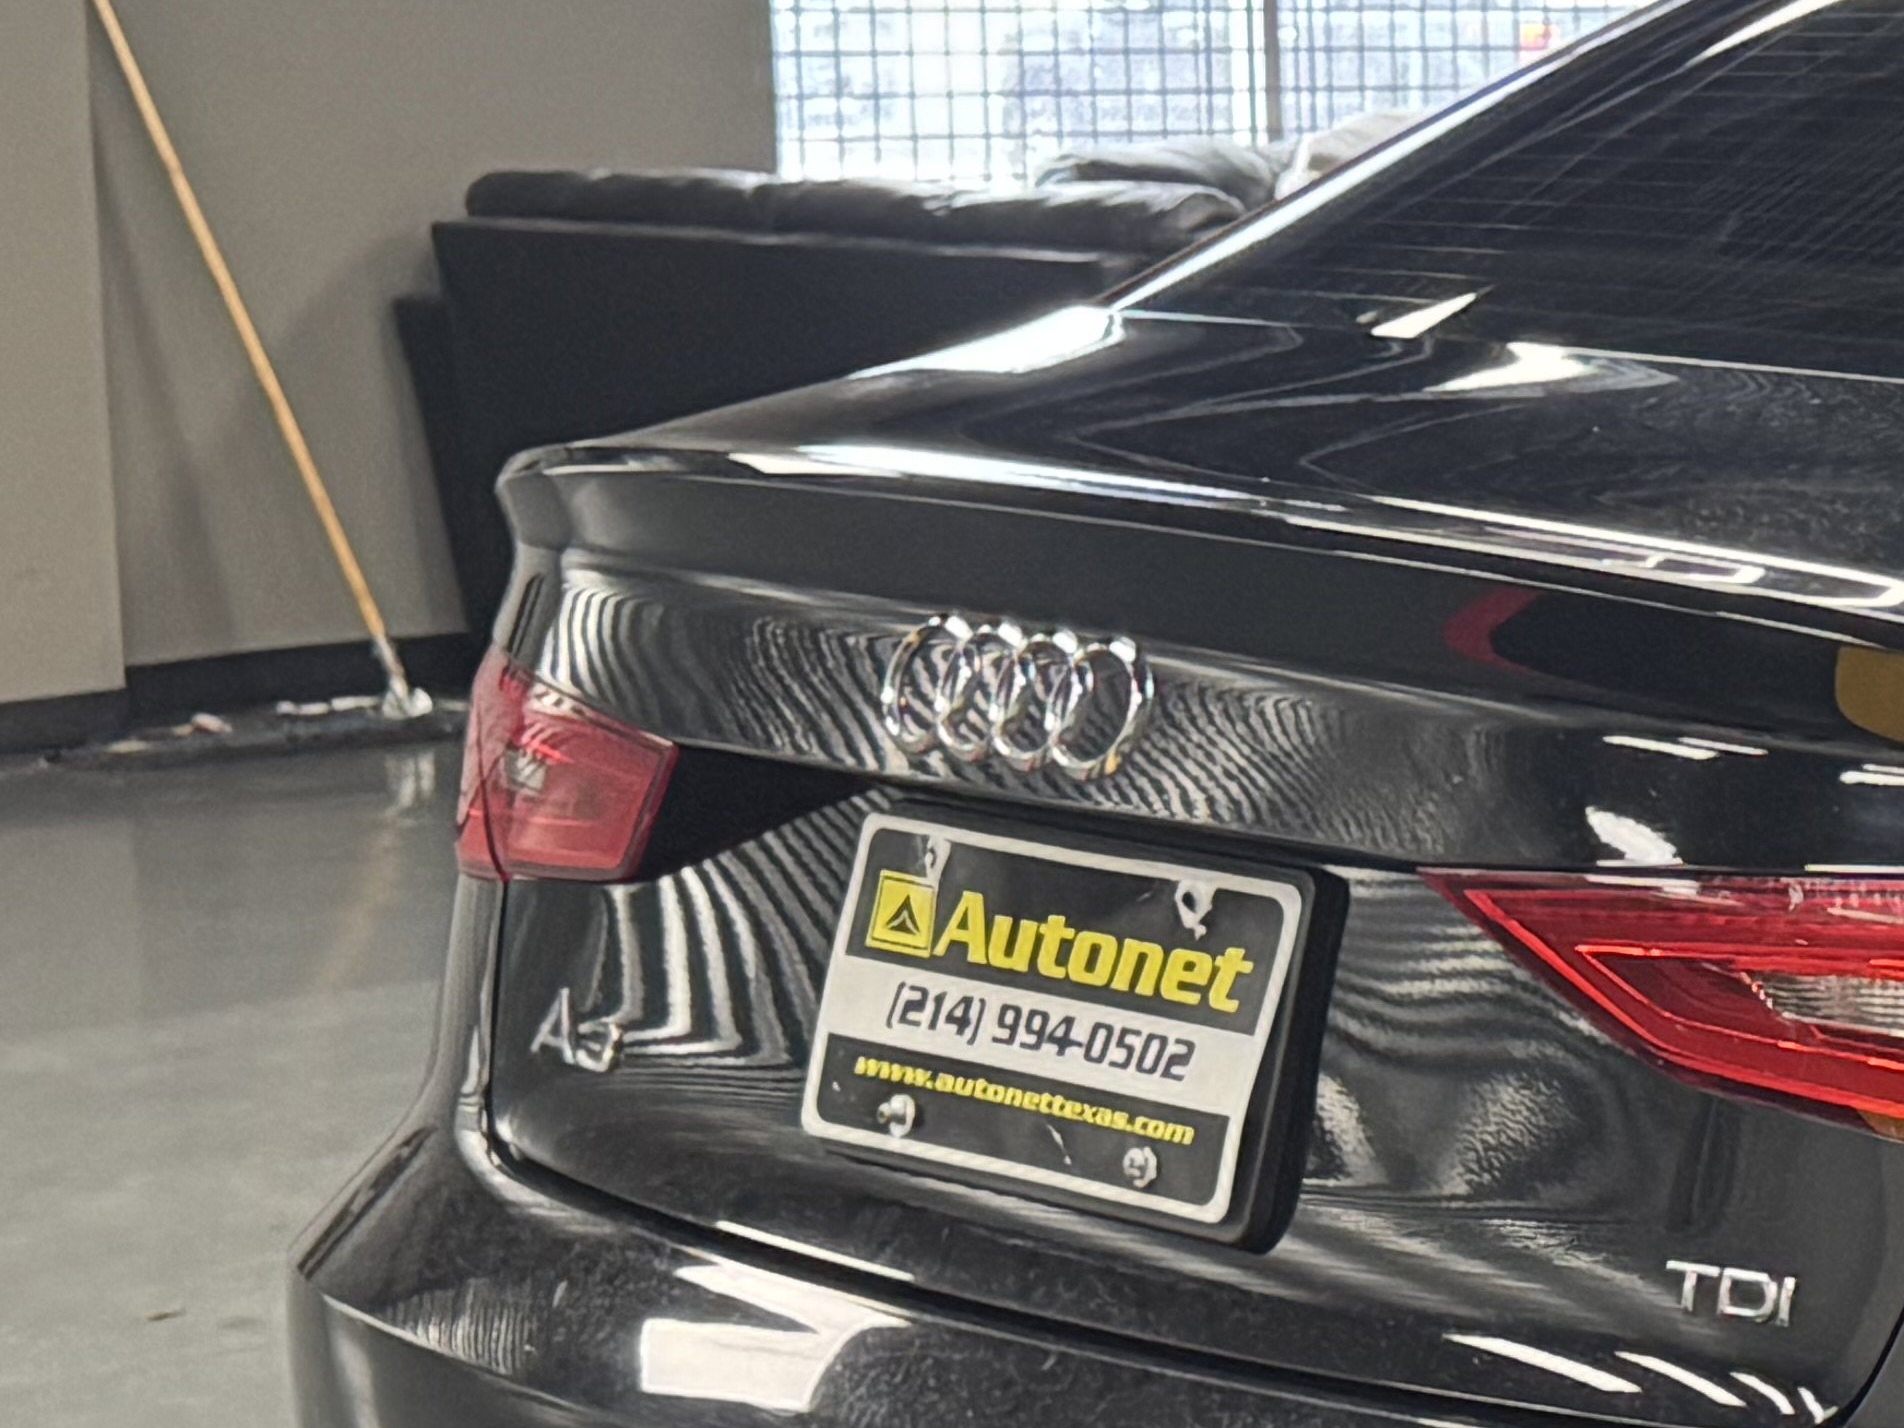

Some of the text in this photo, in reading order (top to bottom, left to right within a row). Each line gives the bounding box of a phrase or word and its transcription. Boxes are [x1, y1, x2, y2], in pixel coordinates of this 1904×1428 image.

[931, 890, 1254, 1013] Autonet
[529, 986, 623, 1072] A3
[885, 981, 1197, 1082] (214) 994-0502
[853, 1055, 1195, 1146] www.autonettexas.com
[1665, 1259, 1798, 1327] TDI
